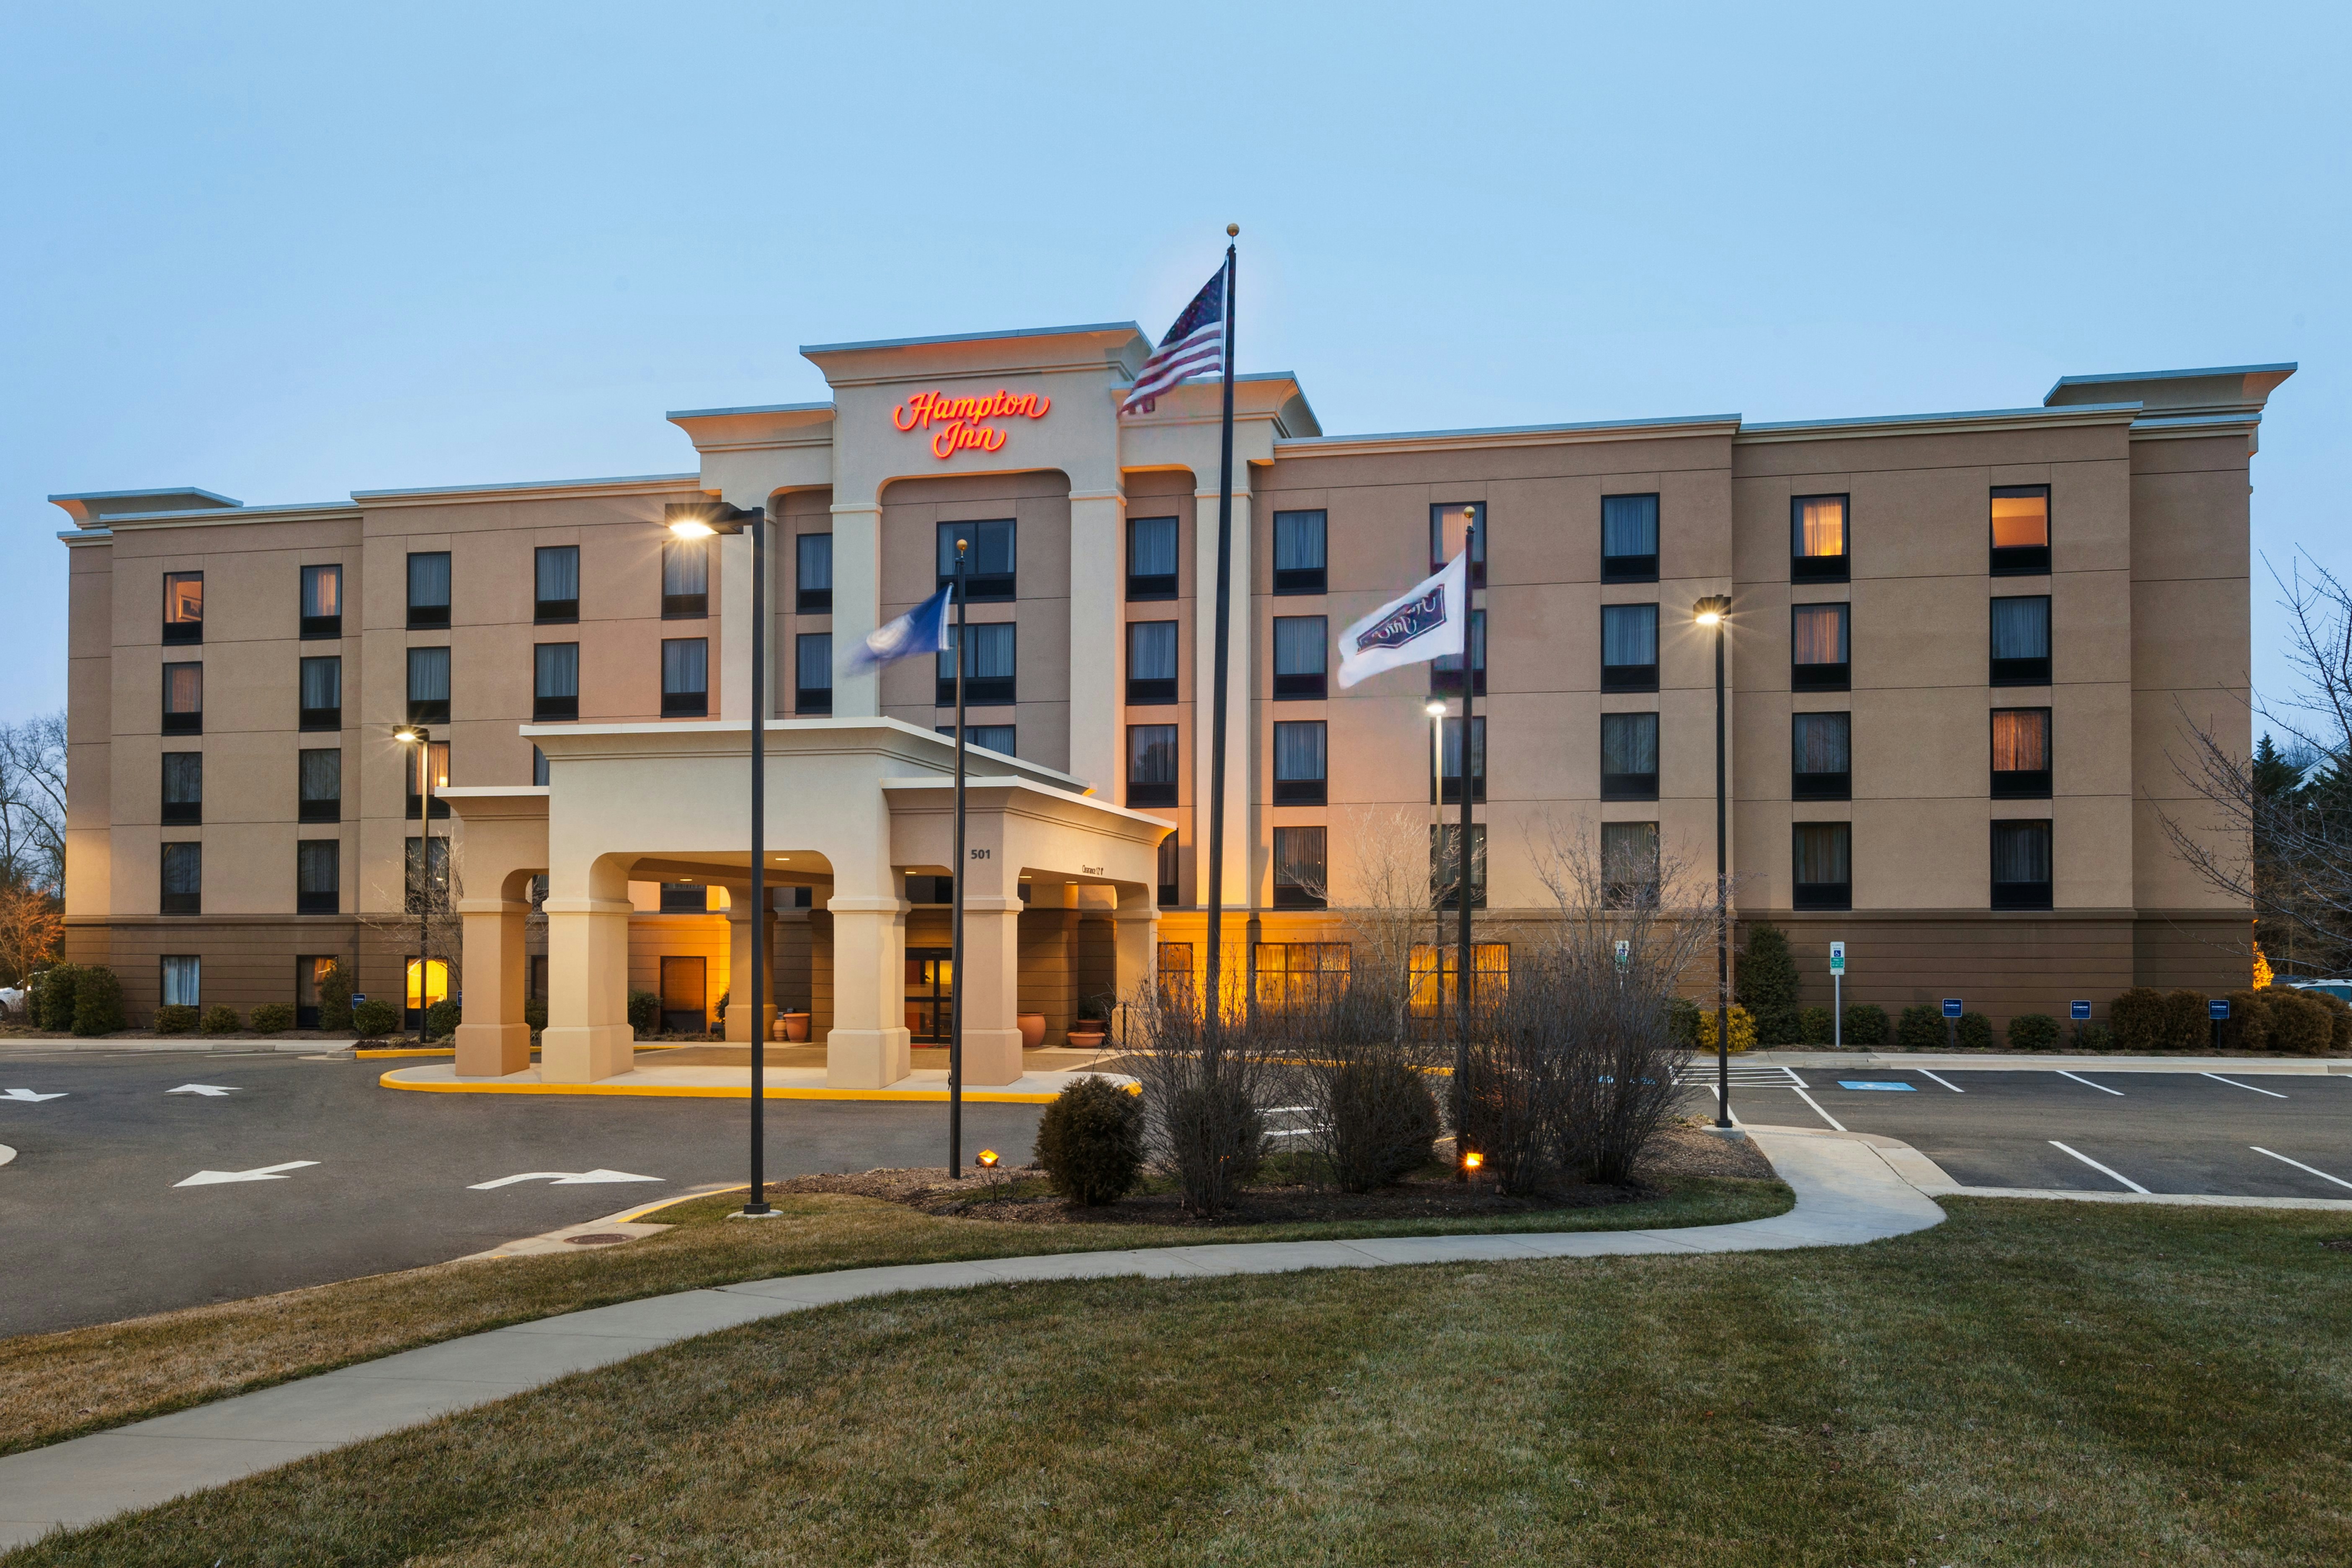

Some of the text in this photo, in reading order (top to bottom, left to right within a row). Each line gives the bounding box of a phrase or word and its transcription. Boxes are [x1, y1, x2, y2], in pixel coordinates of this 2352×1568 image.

[893, 389, 1050, 430] Hampton
[933, 420, 1006, 458] Inn
[971, 849, 990, 859] 501
[1082, 864, 1096, 874] Clearance
